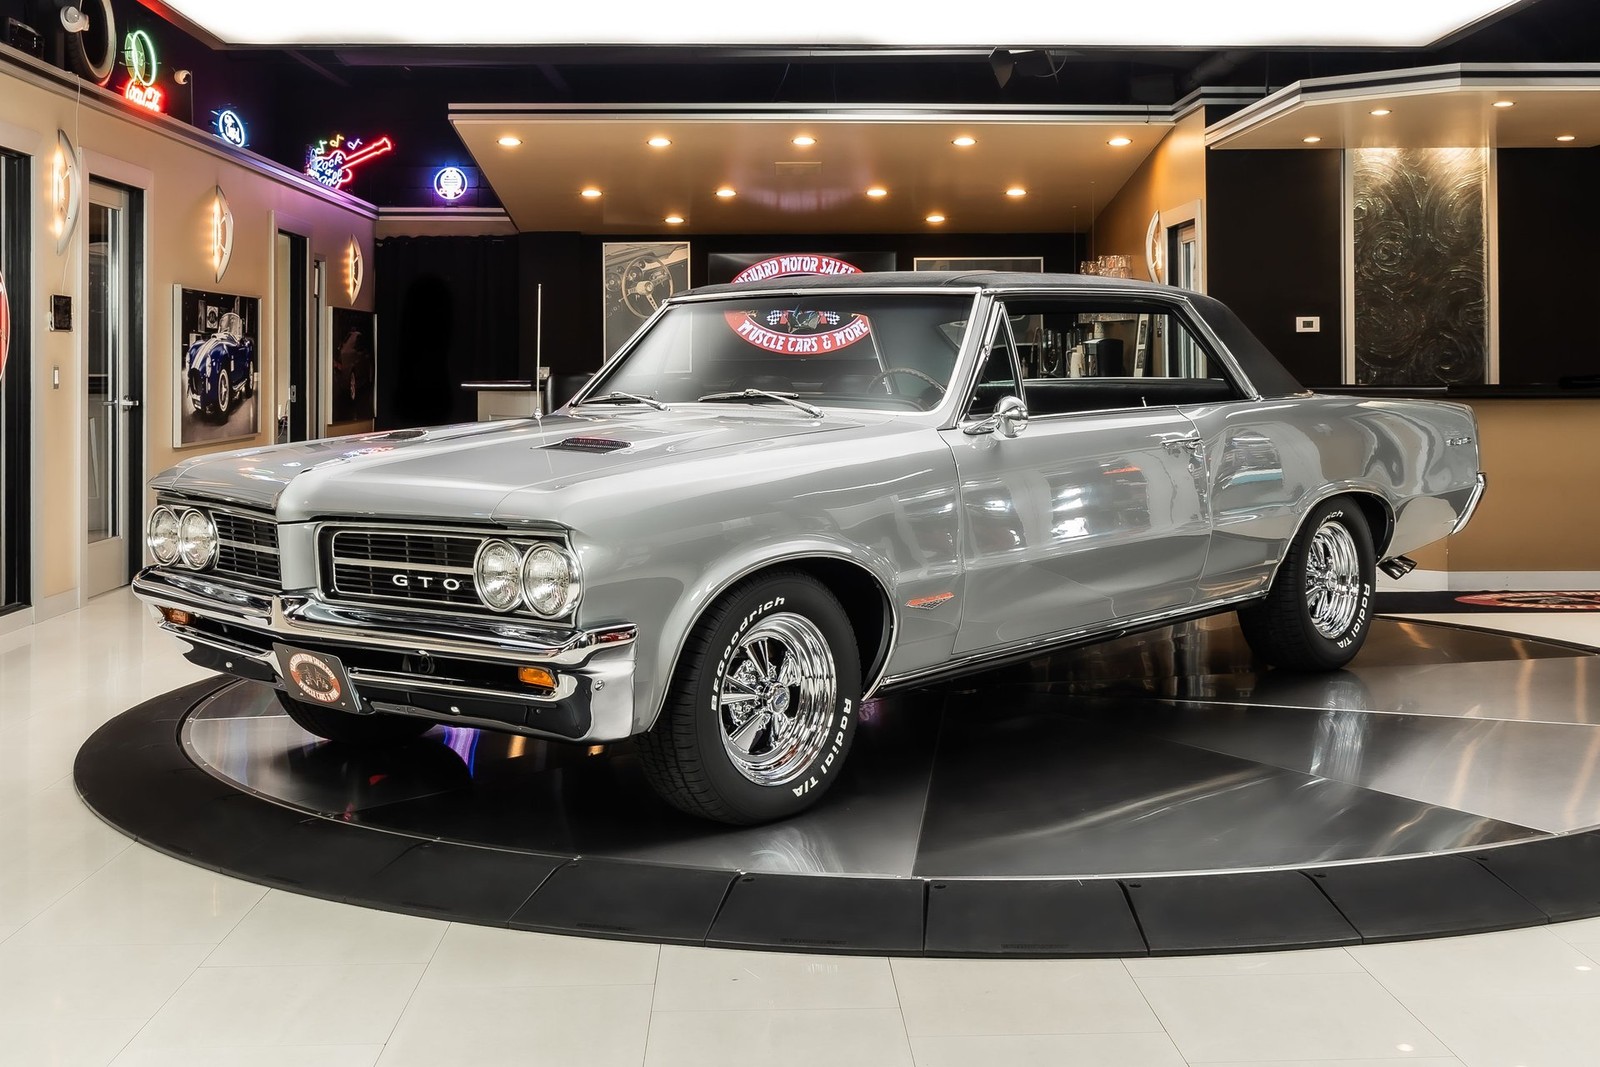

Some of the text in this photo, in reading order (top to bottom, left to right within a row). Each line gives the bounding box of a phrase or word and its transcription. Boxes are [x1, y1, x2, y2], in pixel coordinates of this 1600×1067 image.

[780, 256, 819, 273] MOTOR
[737, 320, 868, 352] MUSCLE CARS & MORE
[392, 574, 460, 591] GTO
[711, 597, 785, 711] BFGoodrich
[792, 698, 852, 798] Radial T/A
